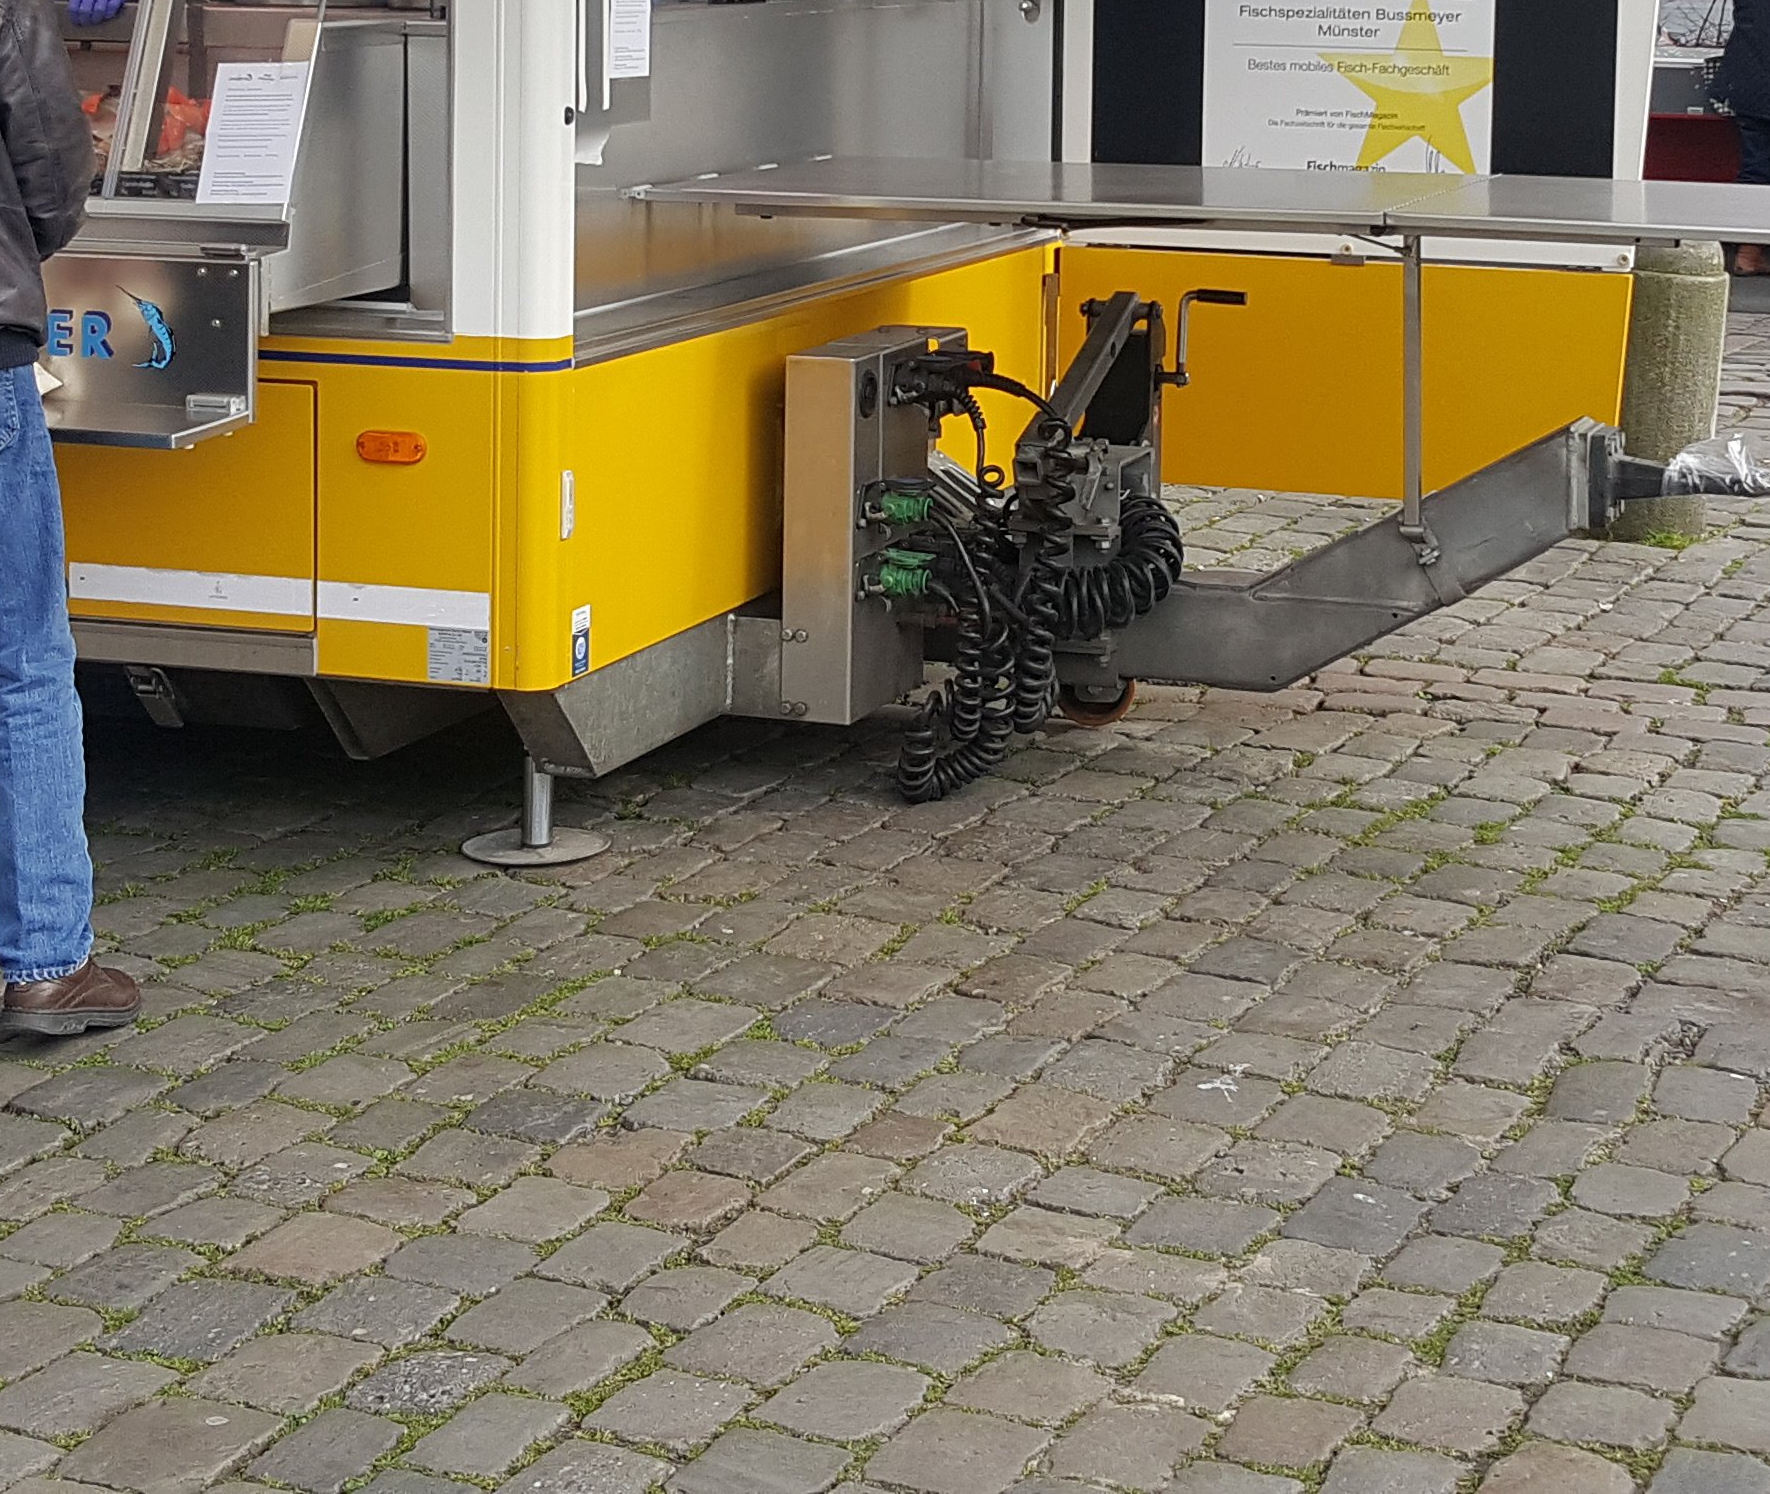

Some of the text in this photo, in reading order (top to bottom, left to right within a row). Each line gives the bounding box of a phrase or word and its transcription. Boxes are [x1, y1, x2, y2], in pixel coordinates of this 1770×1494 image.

[1239, 5, 1462, 25] Fischspezialitäten Bussmeyer
[1317, 24, 1381, 39] Münster
[1247, 58, 1451, 78] Bestes mobiles Fisch-Fachgeschäft
[46, 308, 114, 359] ER
